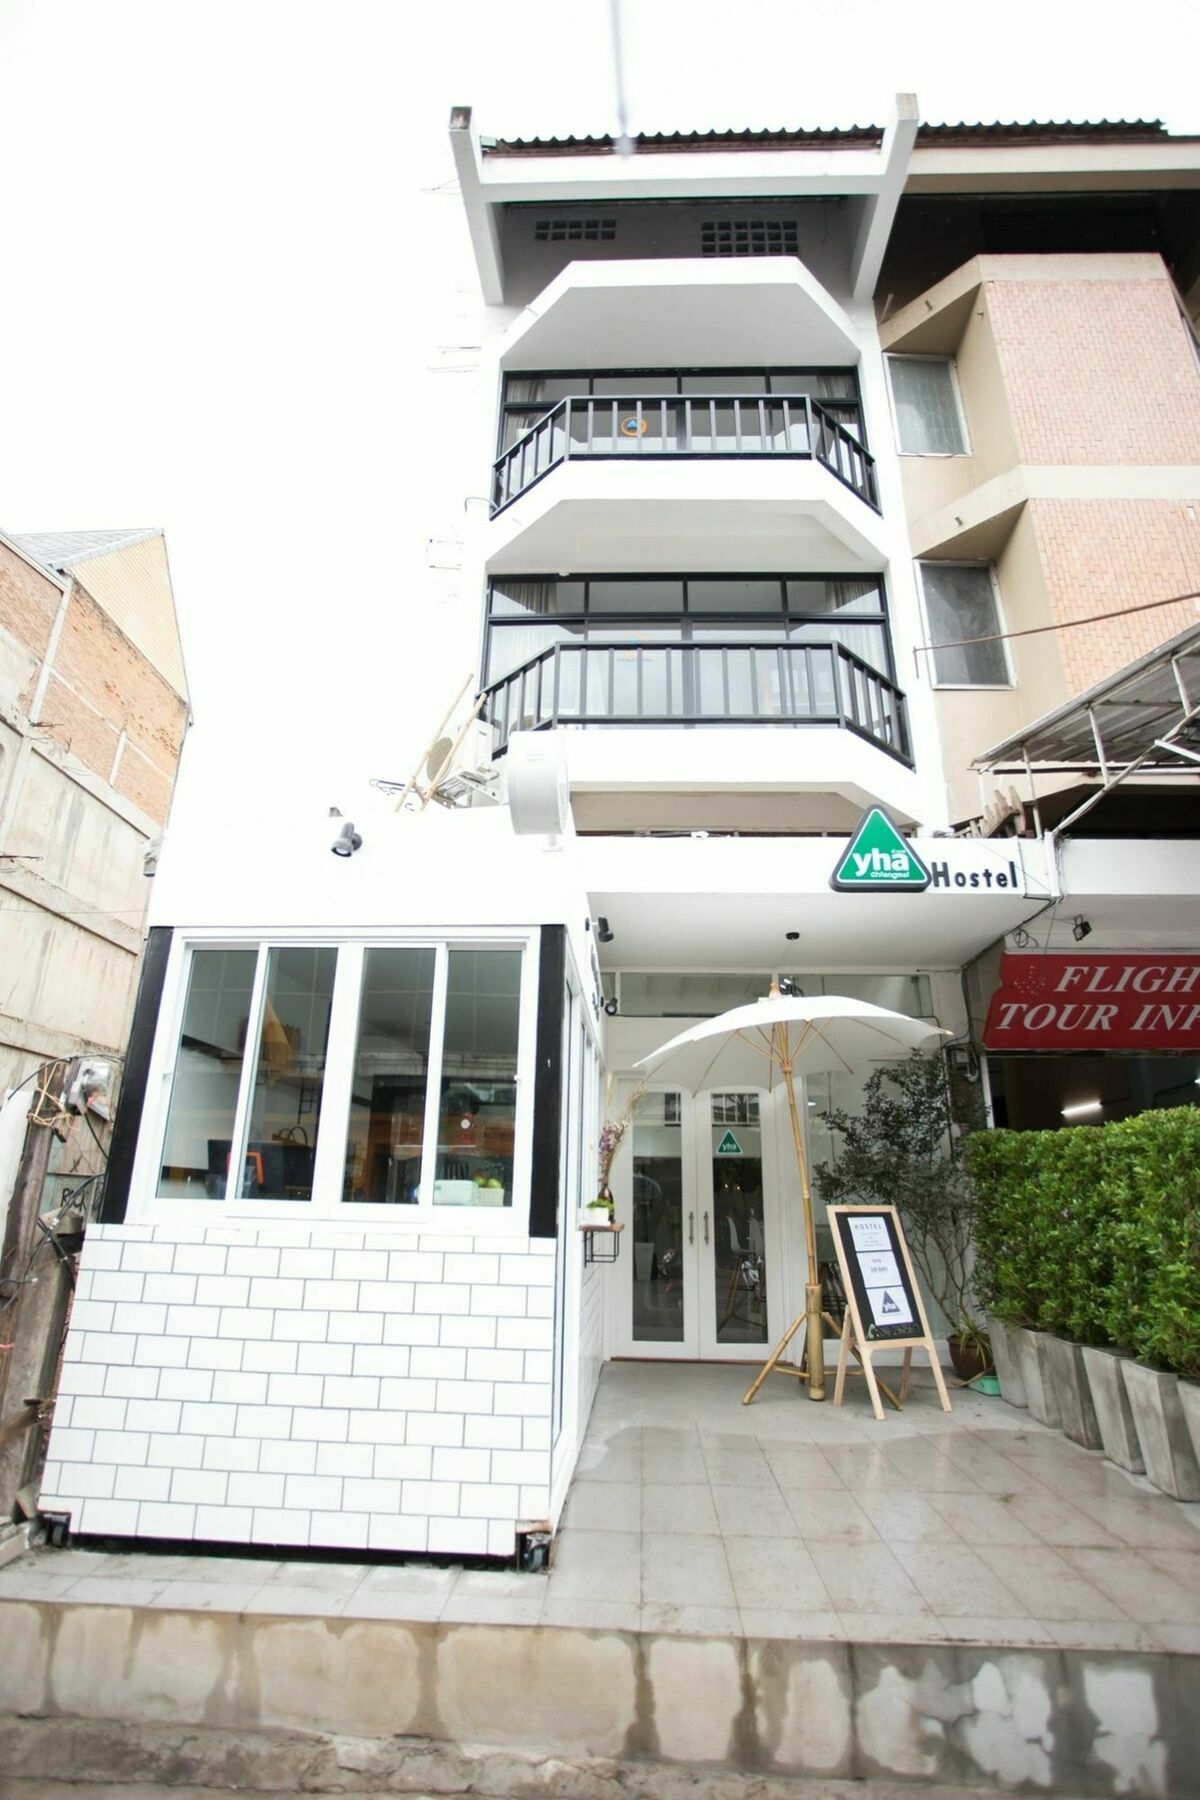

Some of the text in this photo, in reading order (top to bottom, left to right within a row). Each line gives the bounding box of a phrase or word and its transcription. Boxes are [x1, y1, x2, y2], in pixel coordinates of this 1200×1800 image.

[852, 848, 910, 877] yha
[931, 861, 1018, 888] Hostel
[1053, 966, 1200, 993] FLIGH
[995, 1003, 1119, 1031] TOUR
